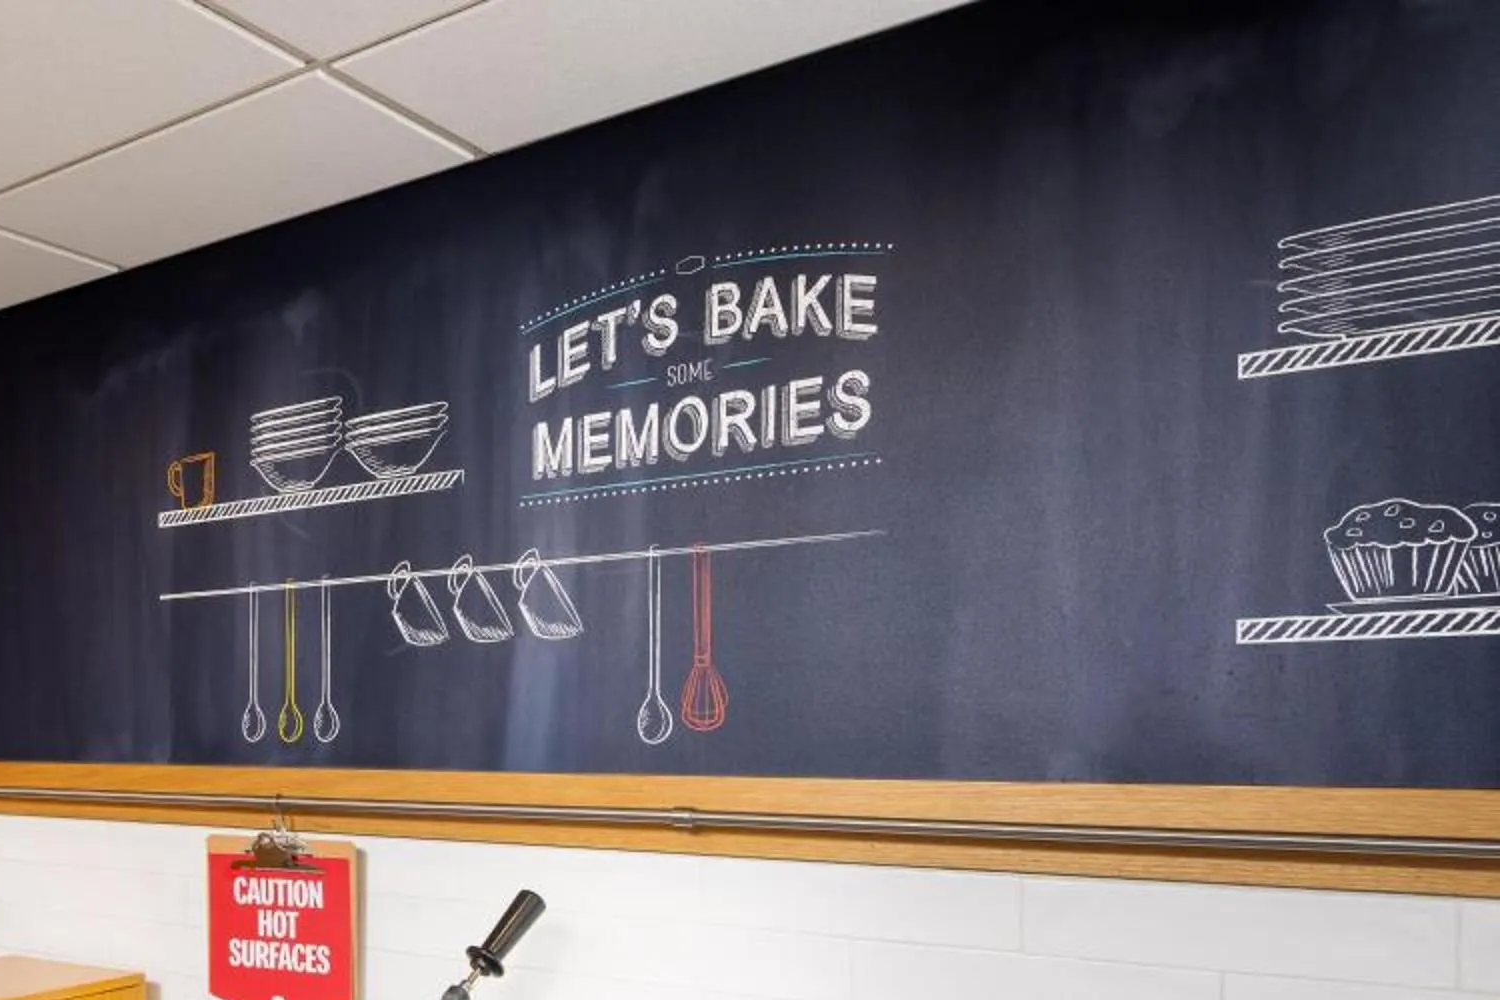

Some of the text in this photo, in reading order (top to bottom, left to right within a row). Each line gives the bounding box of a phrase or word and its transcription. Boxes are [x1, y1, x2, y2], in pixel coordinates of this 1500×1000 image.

[529, 273, 878, 403] LET'S BAKE
[667, 358, 715, 387] SOME
[532, 369, 872, 481] MEMORIES
[233, 877, 324, 909] CAUTION
[258, 910, 299, 939] HOT
[229, 938, 331, 975] SURFACES
